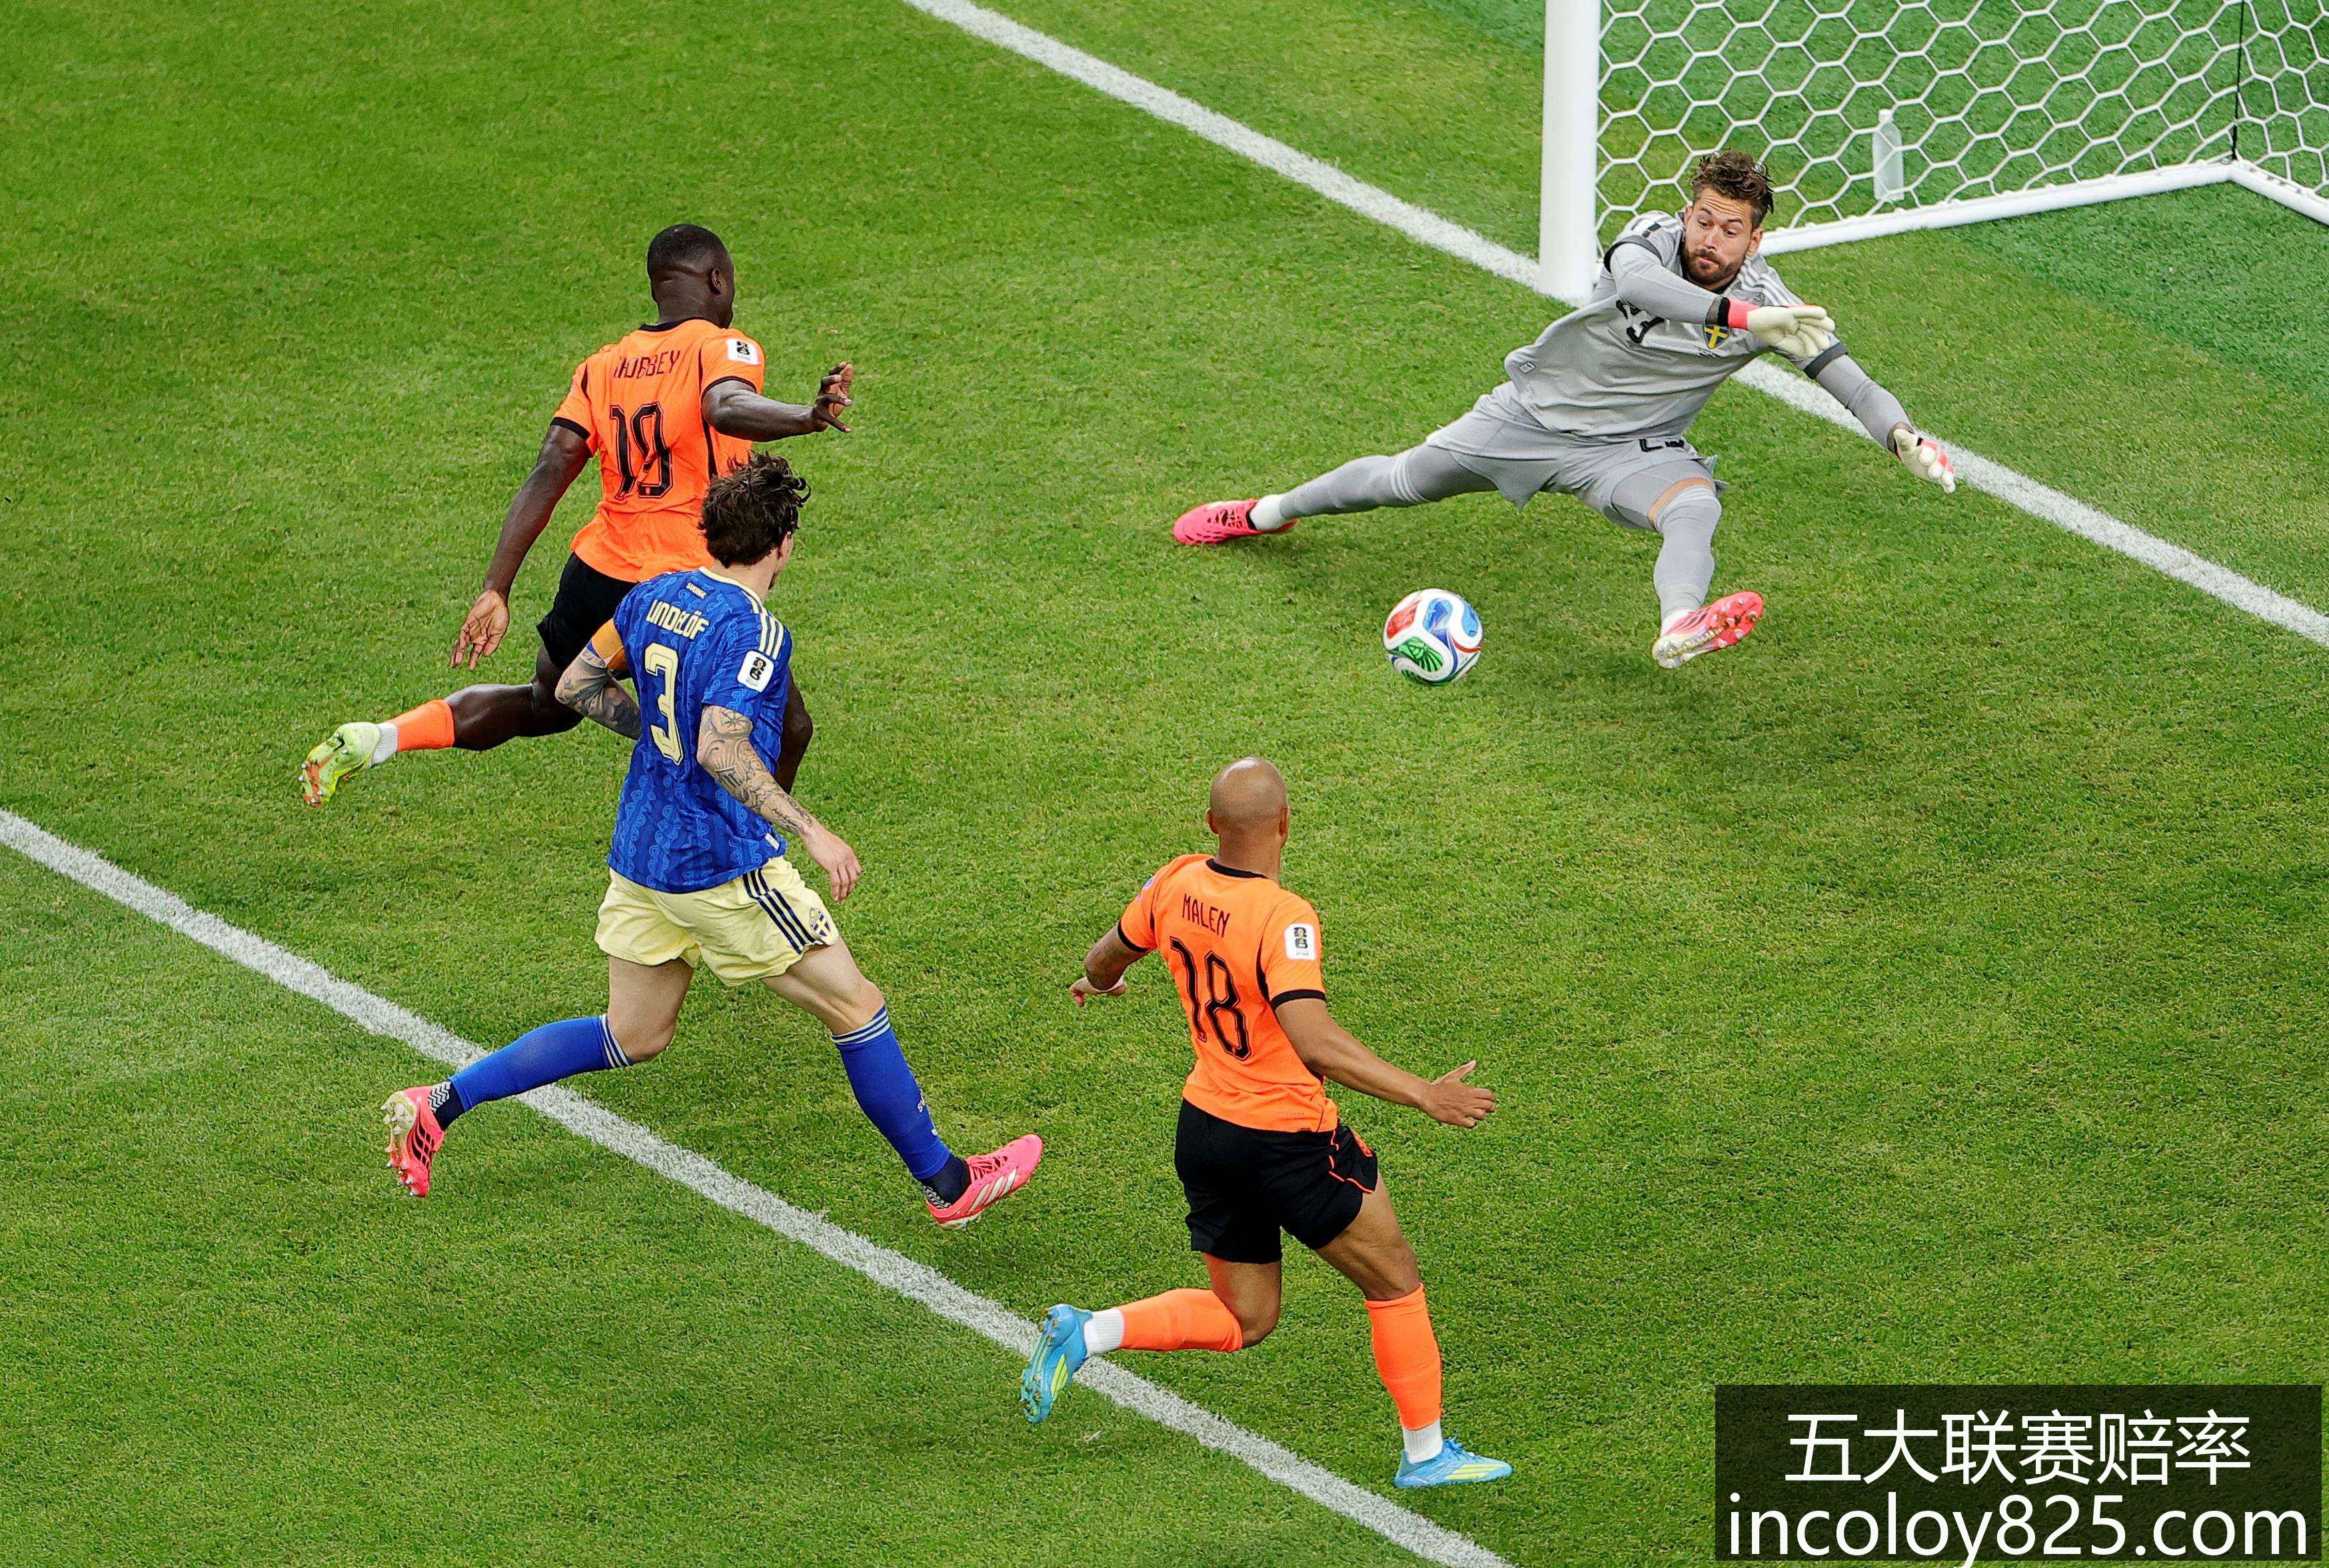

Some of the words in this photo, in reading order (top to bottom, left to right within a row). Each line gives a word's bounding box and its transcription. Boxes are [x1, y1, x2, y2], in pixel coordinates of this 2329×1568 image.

[609, 400, 673, 501] 19
[644, 642, 684, 766] 3
[1181, 894, 1231, 938] MALEN
[1169, 936, 1251, 1062] 18
